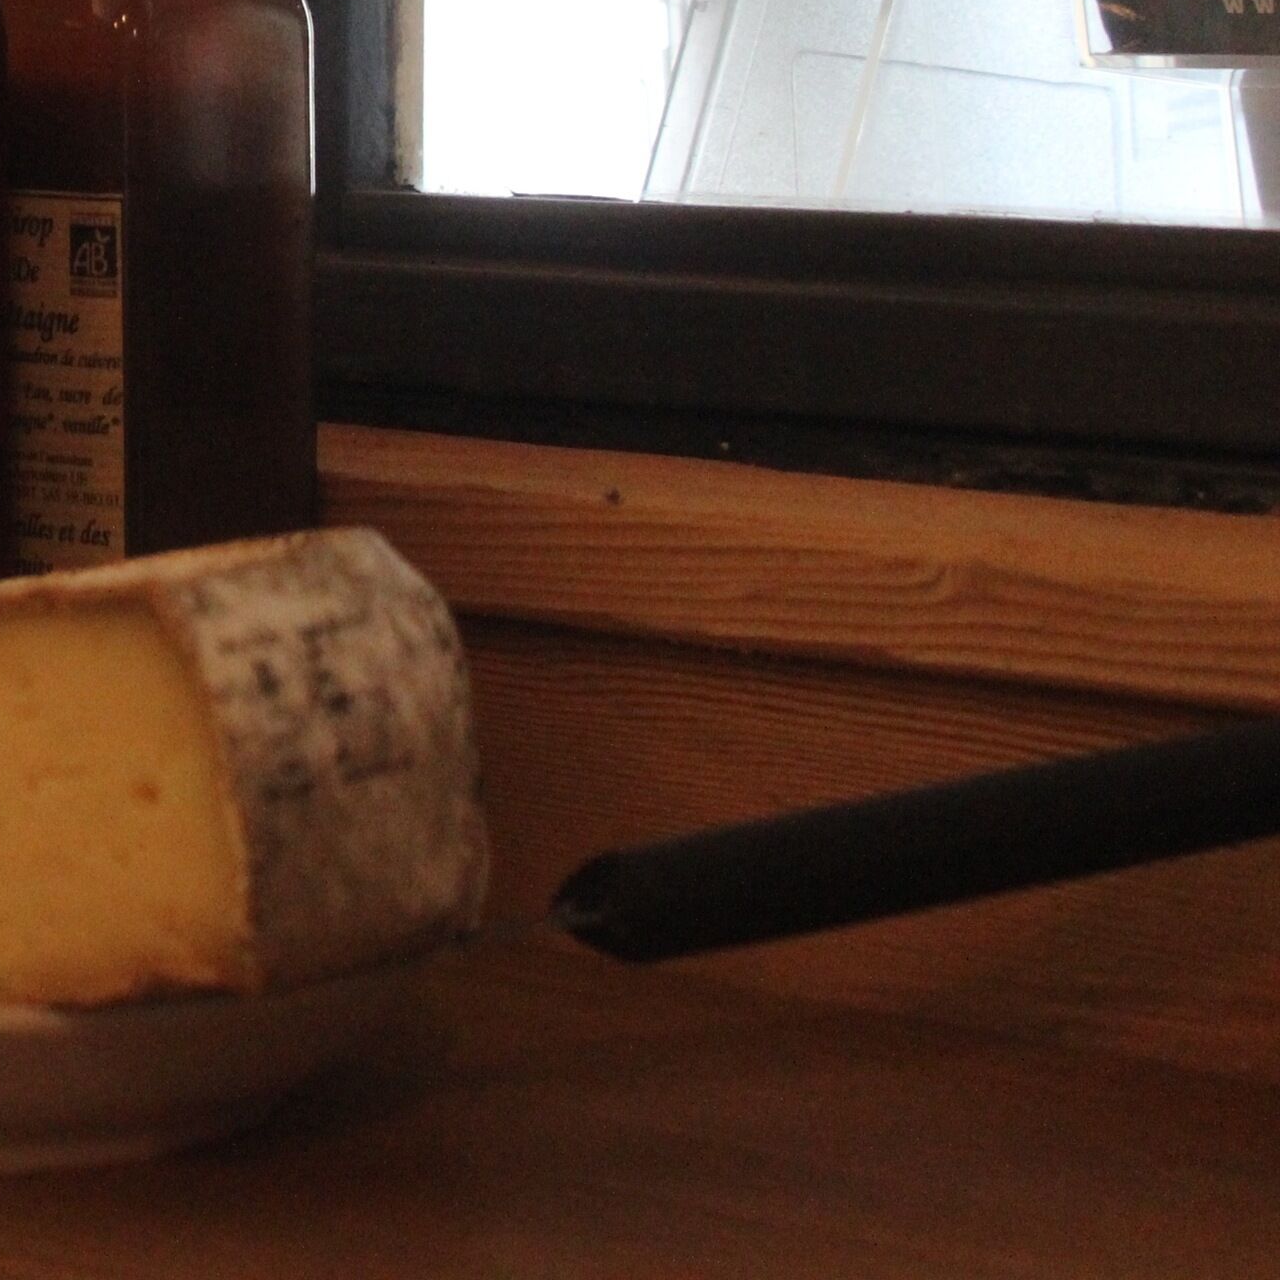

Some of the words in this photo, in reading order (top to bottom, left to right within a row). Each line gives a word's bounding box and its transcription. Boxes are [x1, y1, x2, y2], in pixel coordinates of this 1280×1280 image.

[73, 240, 108, 276] AB
[57, 522, 76, 544] et
[79, 519, 112, 547] des
